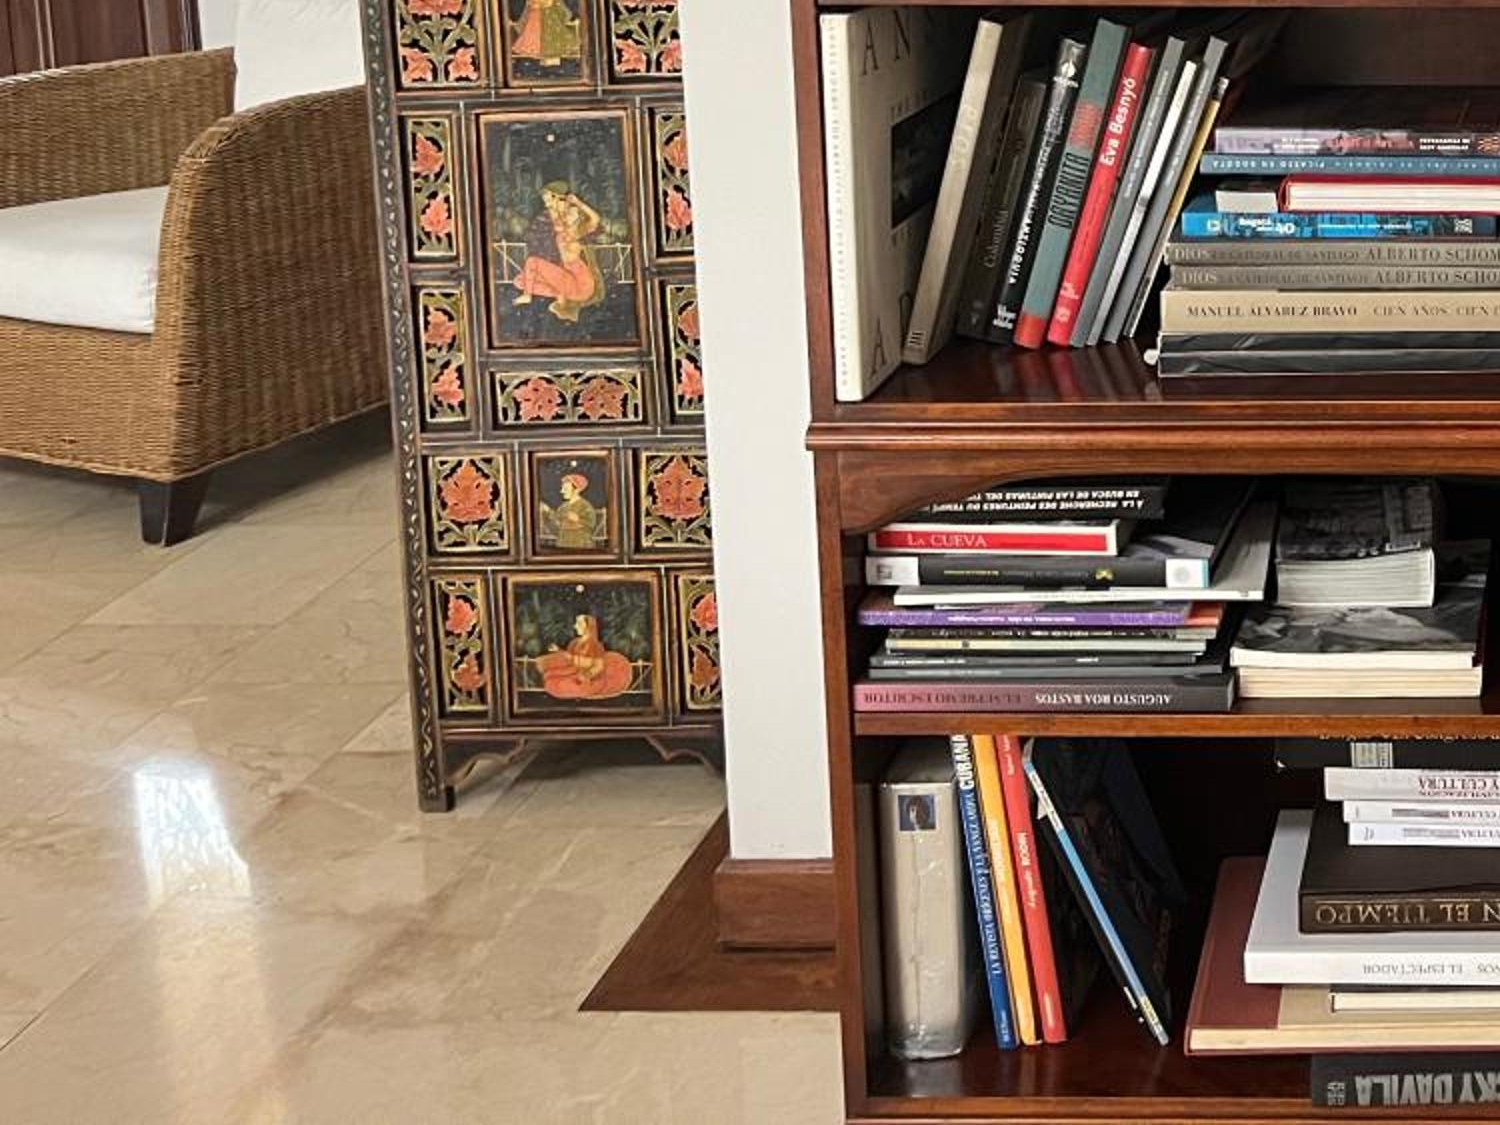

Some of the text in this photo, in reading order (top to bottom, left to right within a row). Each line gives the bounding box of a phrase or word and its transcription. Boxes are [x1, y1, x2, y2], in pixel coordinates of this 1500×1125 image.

[1100, 139, 1121, 166] Eva
[1280, 160, 1325, 169] PICASSO
[1047, 152, 1090, 229] DAYANITA
[1175, 248, 1210, 260] DIOS
[1366, 248, 1440, 261] ALBERTO
[1183, 271, 1217, 282] DIOS
[1375, 270, 1450, 284] ALBERTO
[1188, 306, 1247, 316] MANUEL
[1314, 306, 1358, 316] BRAVO
[1374, 307, 1407, 316] CIEN
[1456, 307, 1490, 316] CIEN
[1005, 491, 1053, 500] PINTURAS
[1059, 502, 1117, 511] RECHERCHE
[931, 534, 987, 547] CUEVA
[864, 693, 1172, 704] AUGUSTO ROA BASTOS EL SUPREMO ESCRITOR
[952, 735, 975, 790] CUBANA
[1418, 777, 1500, 792] Y CULTURA
[1450, 810, 1497, 821] CULTURA
[1016, 832, 1031, 866] RODIN
[1315, 904, 1430, 924] TIEMPO
[1440, 904, 1470, 923] EL
[985, 923, 1000, 960] REVISTA
[991, 962, 1001, 974] LA
[1363, 963, 1446, 975] ESPECTADOR
[1448, 964, 1462, 975] EL
[1355, 1075, 1453, 1106] DAVILA
